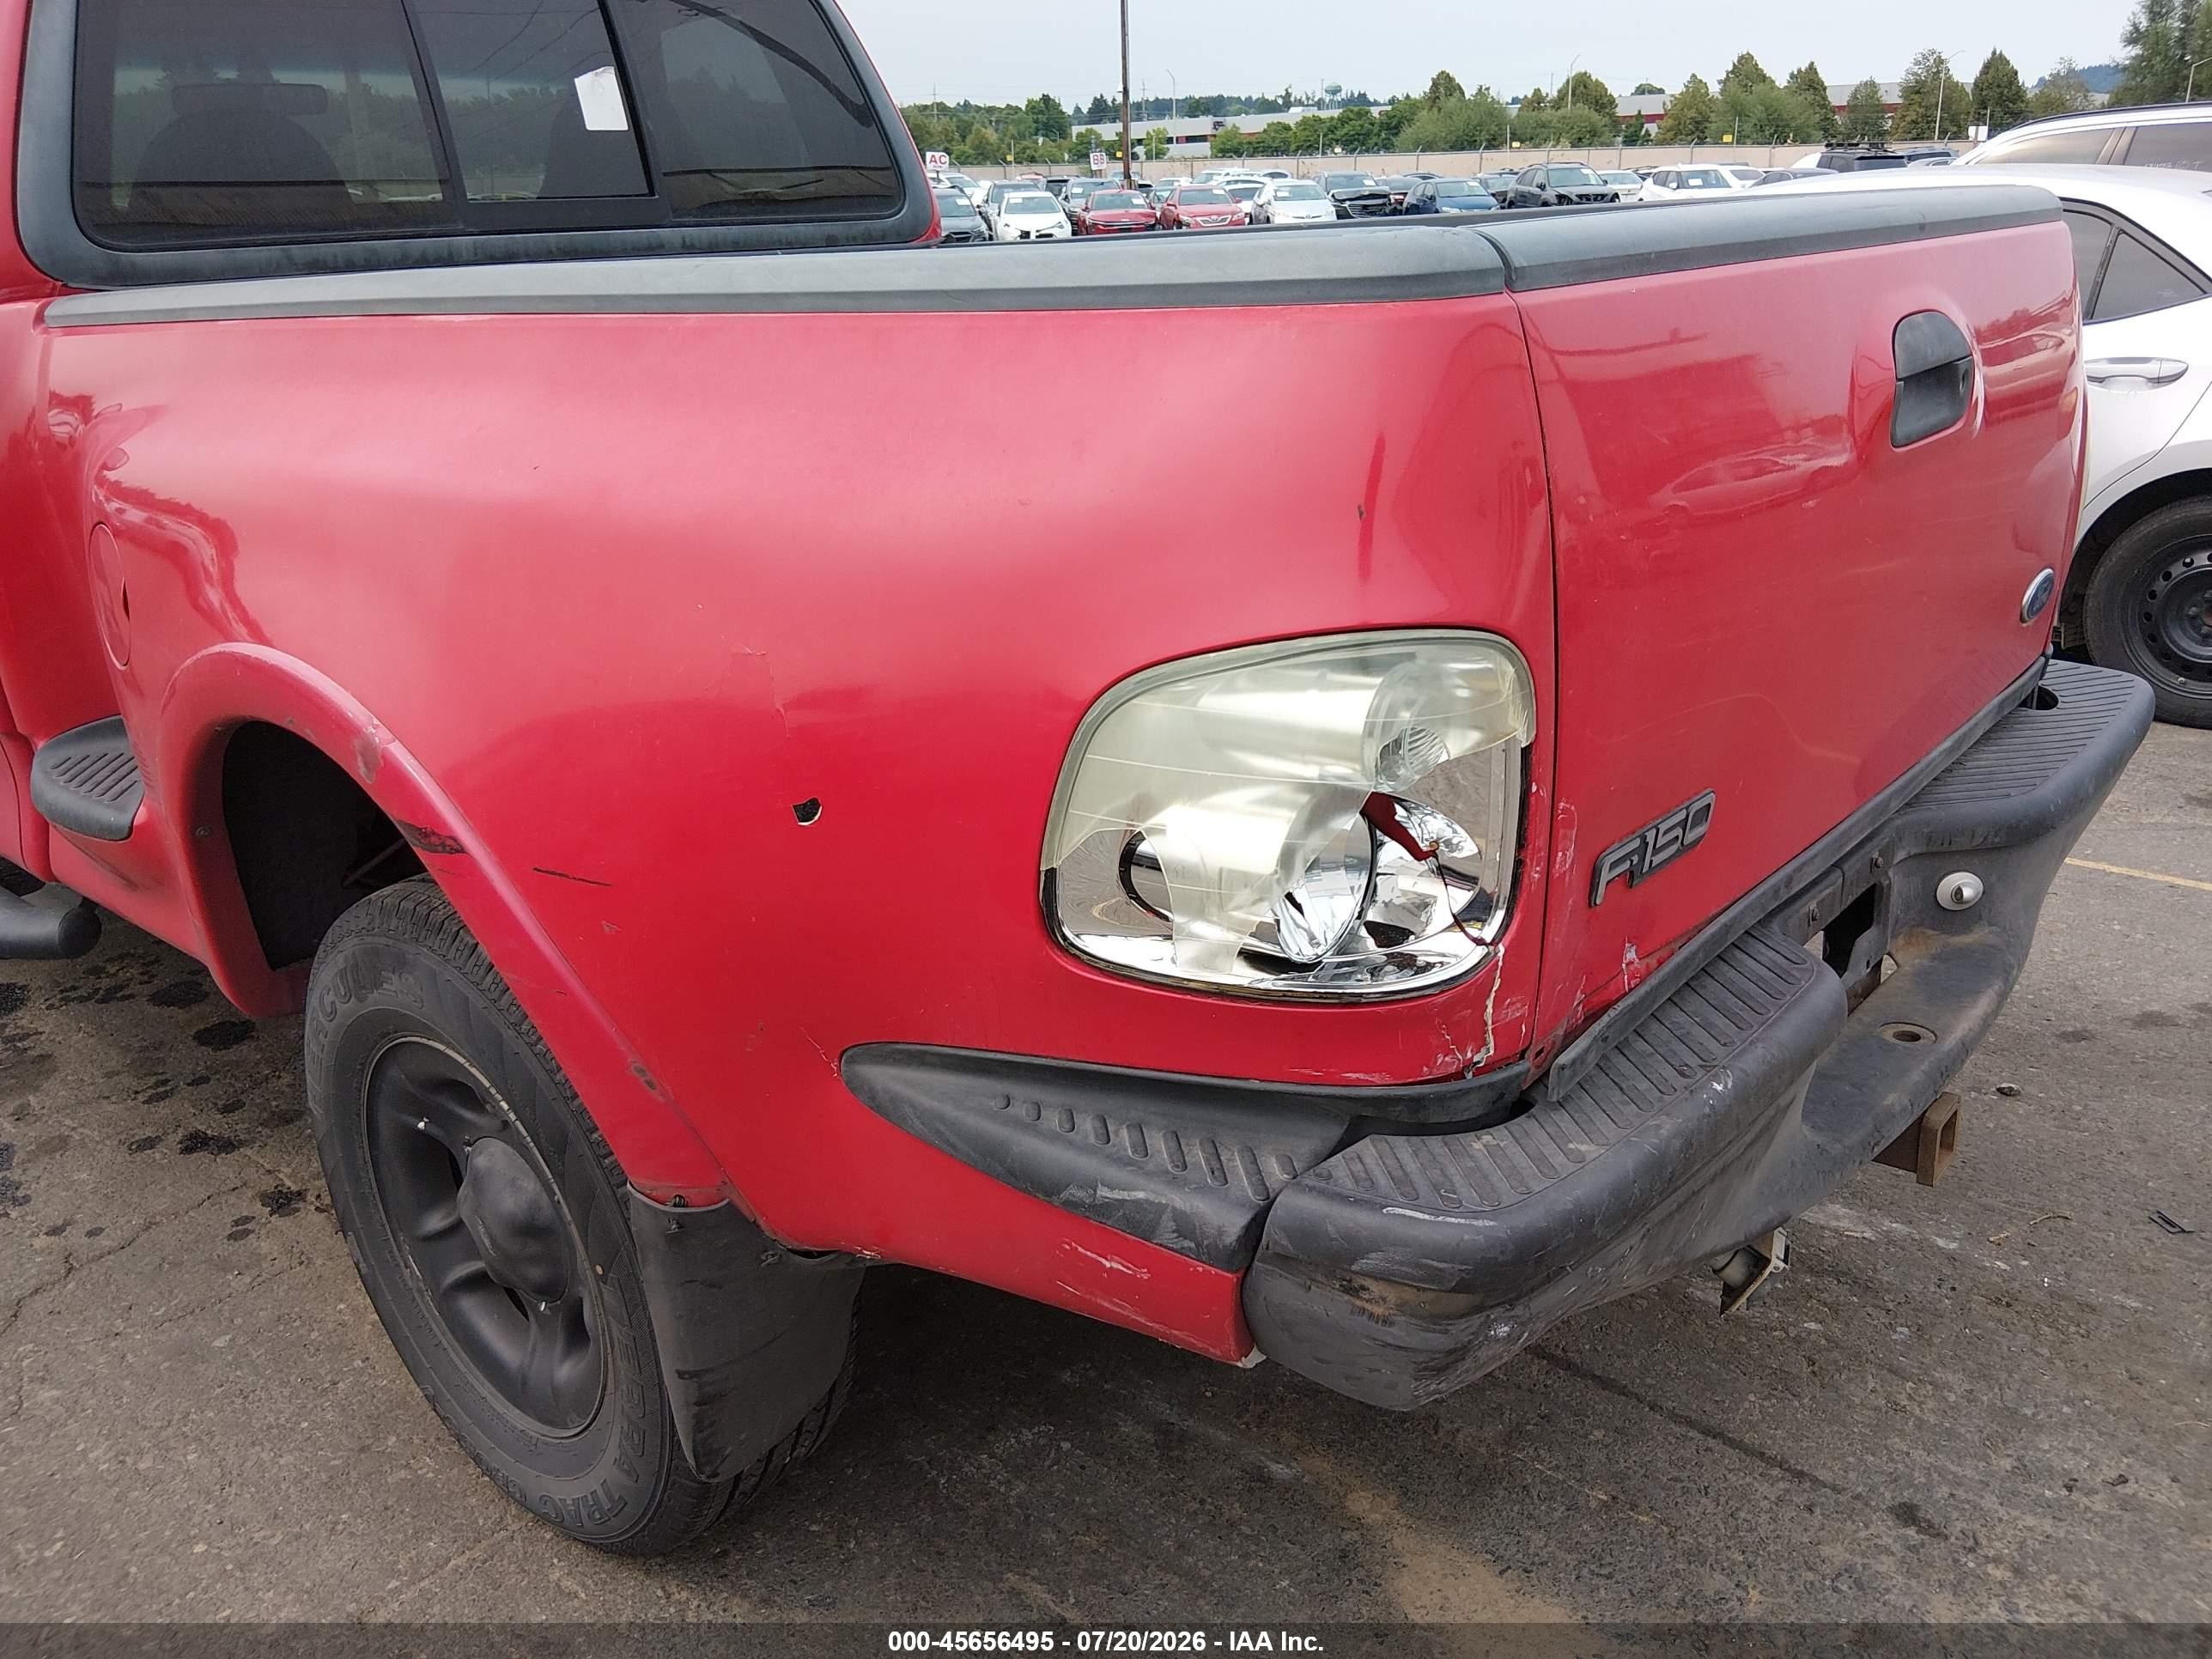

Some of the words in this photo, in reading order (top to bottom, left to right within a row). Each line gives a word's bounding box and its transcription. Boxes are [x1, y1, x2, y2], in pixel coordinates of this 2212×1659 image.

[929, 155, 947, 165] AC
[1092, 155, 1104, 165] BB
[538, 1479, 627, 1527] TRAC
